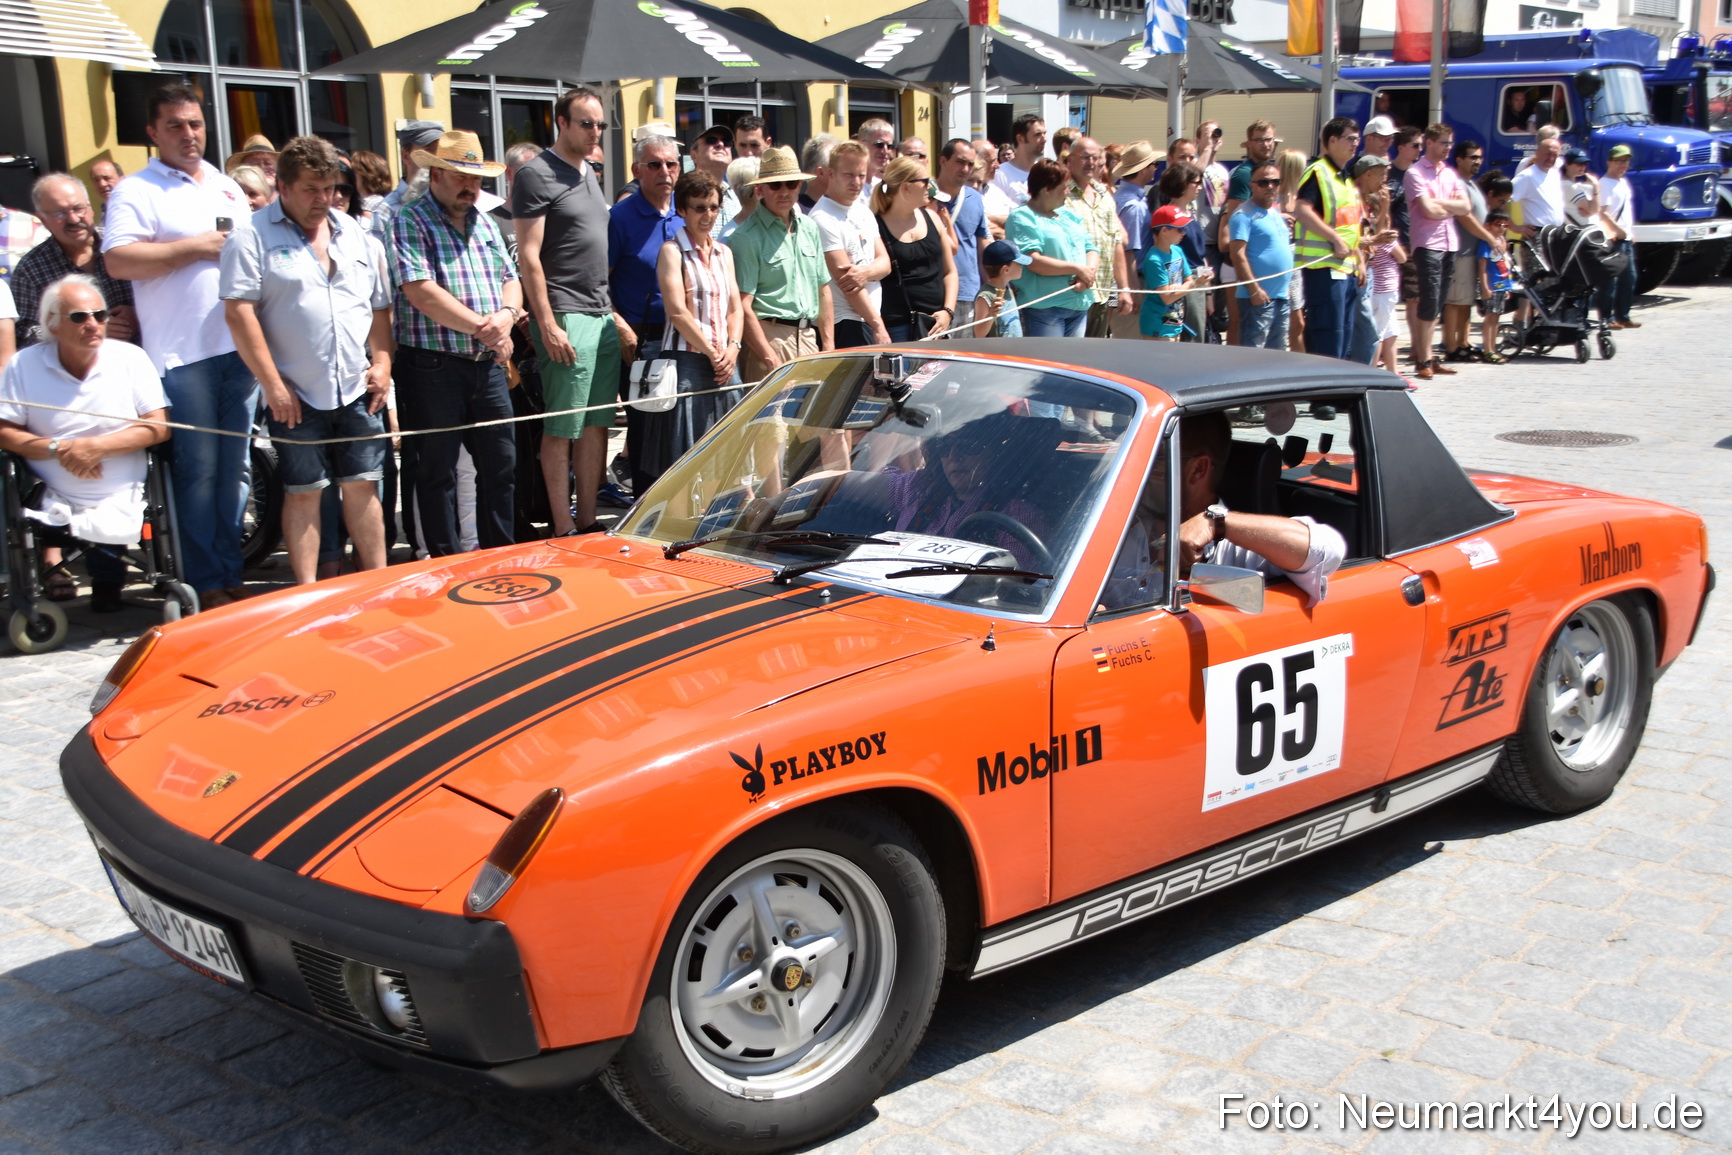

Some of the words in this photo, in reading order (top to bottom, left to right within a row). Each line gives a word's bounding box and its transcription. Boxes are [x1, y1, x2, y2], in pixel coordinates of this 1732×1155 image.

[918, 106, 930, 122] 24
[917, 541, 967, 556] 287
[1579, 521, 1642, 586] Marlboro
[1107, 640, 1139, 656] Fuchs
[1330, 641, 1351, 655] DEKRA
[1445, 611, 1510, 666] ATS
[1112, 651, 1143, 669] Fuchs
[1145, 649, 1156, 662] C.
[197, 695, 300, 718] BOSCH
[1235, 650, 1319, 776] 65
[769, 731, 887, 786] PLAYBOY
[976, 733, 1069, 796] Mobil
[1077, 812, 1347, 937] PORSCHE
